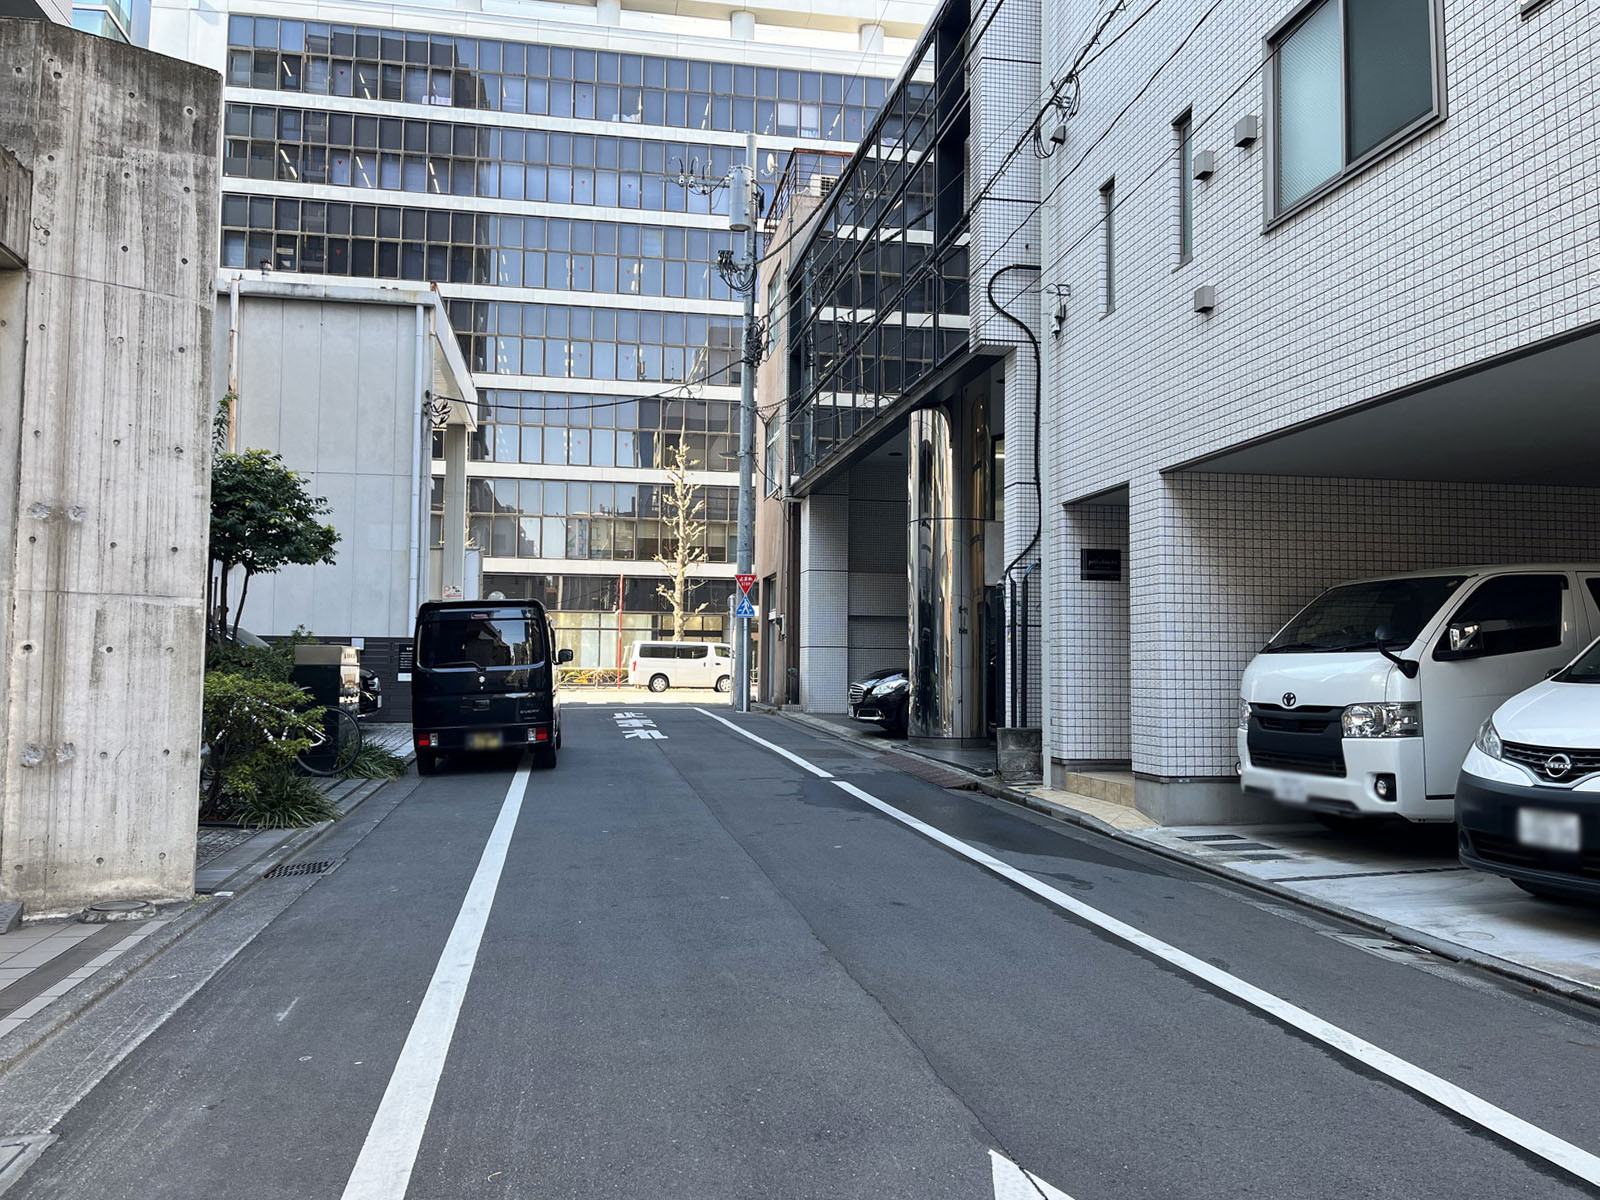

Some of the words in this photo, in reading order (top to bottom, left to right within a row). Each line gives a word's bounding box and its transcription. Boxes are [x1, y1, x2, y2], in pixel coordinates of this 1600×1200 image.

[613, 711, 669, 739] 止まれ
[1544, 762, 1572, 770] NISSAN
